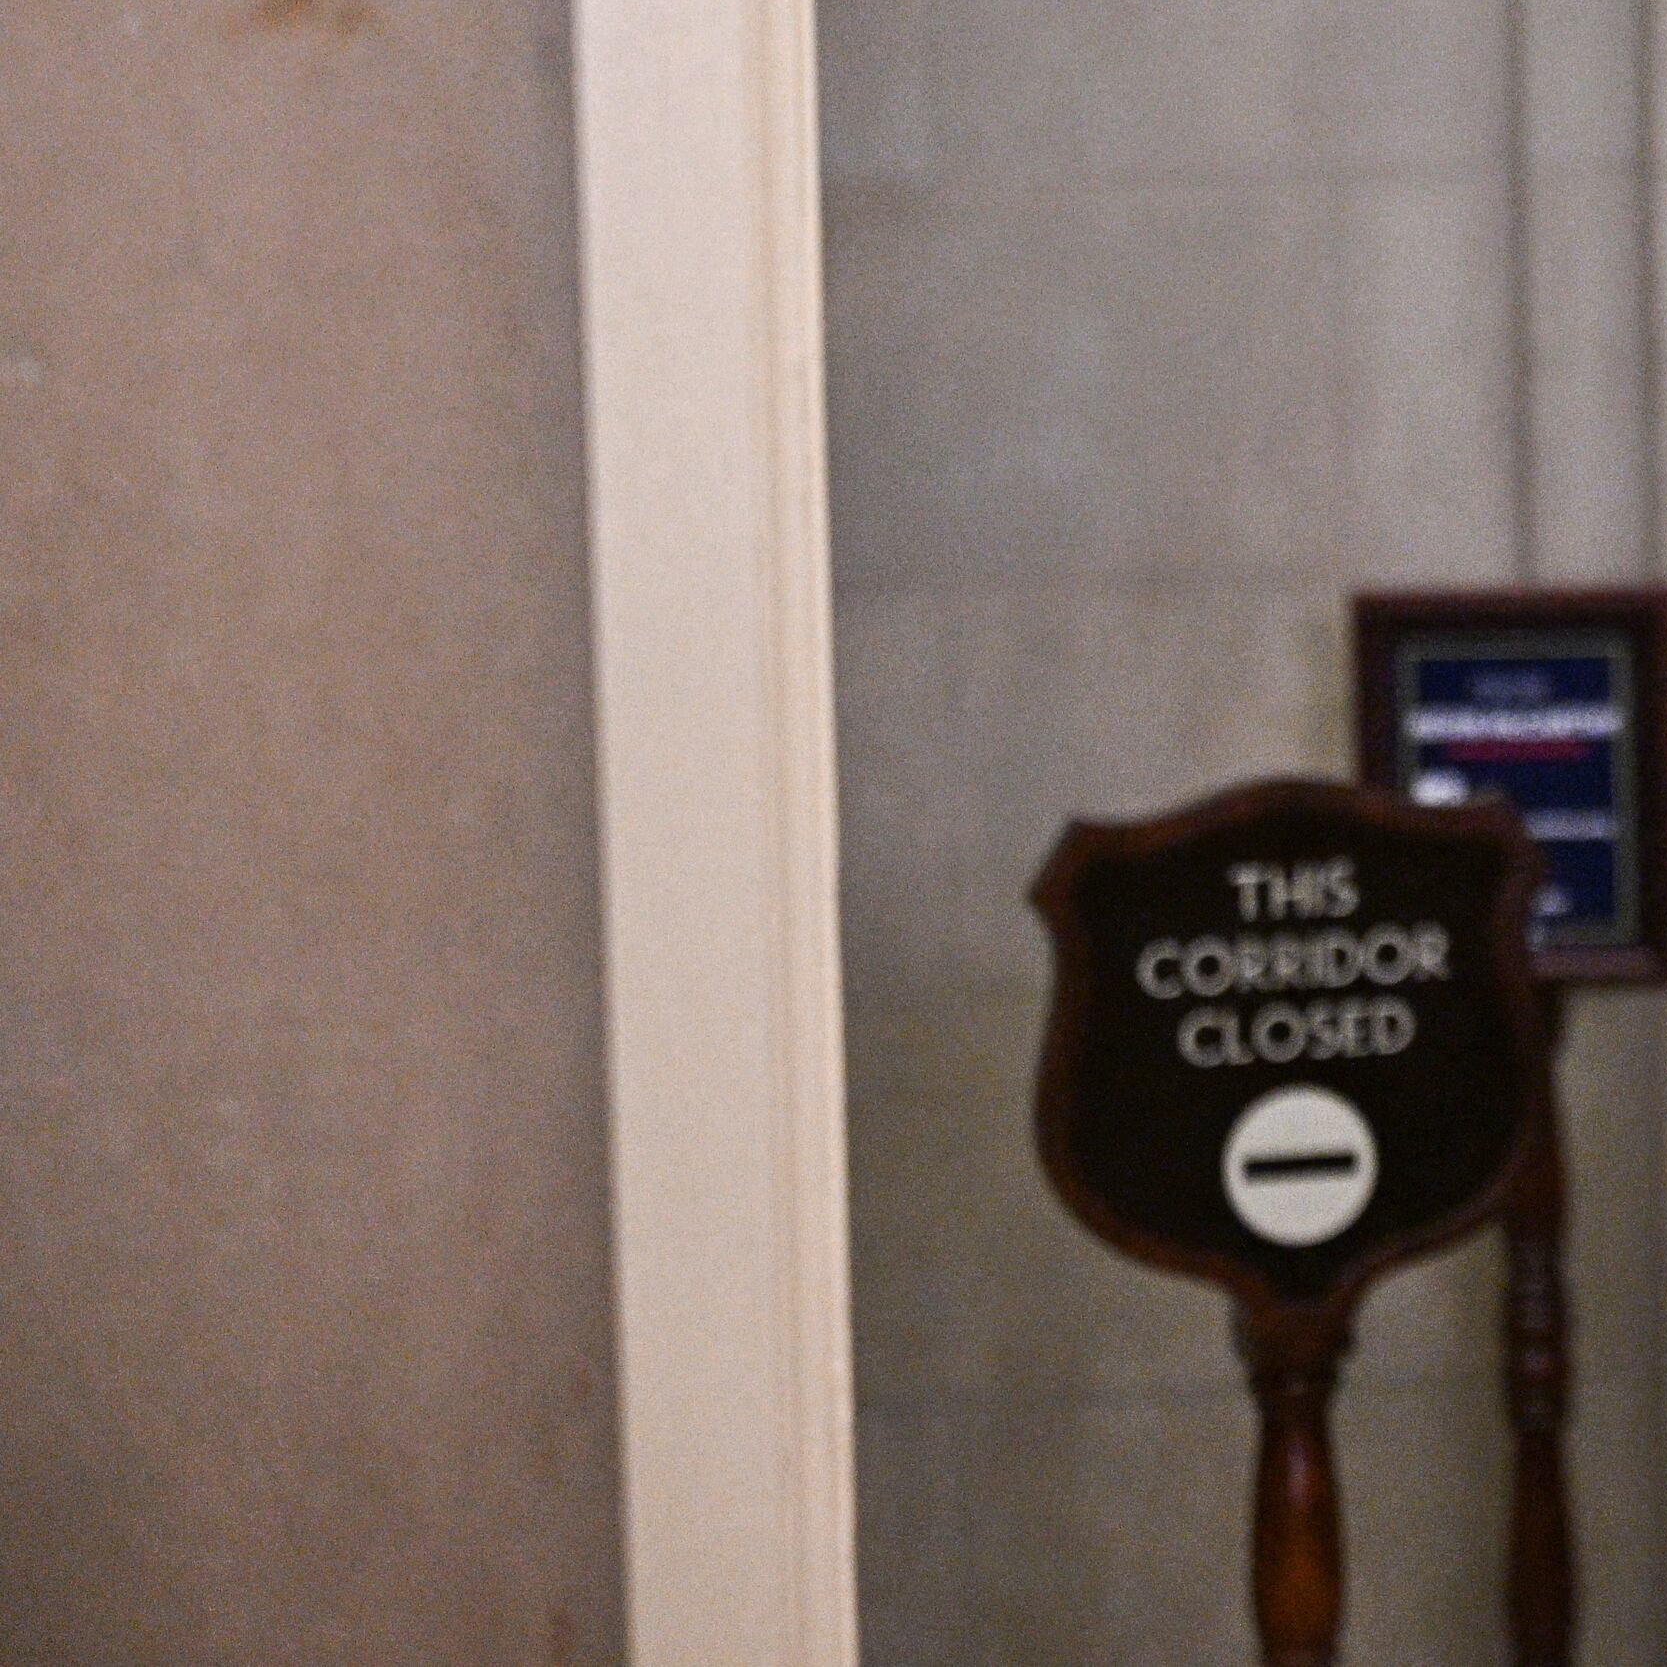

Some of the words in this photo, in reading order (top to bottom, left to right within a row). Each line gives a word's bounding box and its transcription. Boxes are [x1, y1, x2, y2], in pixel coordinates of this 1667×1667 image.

[1227, 854, 1360, 922] THIS
[1135, 919, 1452, 1001] CORRIDOR
[1176, 993, 1418, 1069] CLOSED
